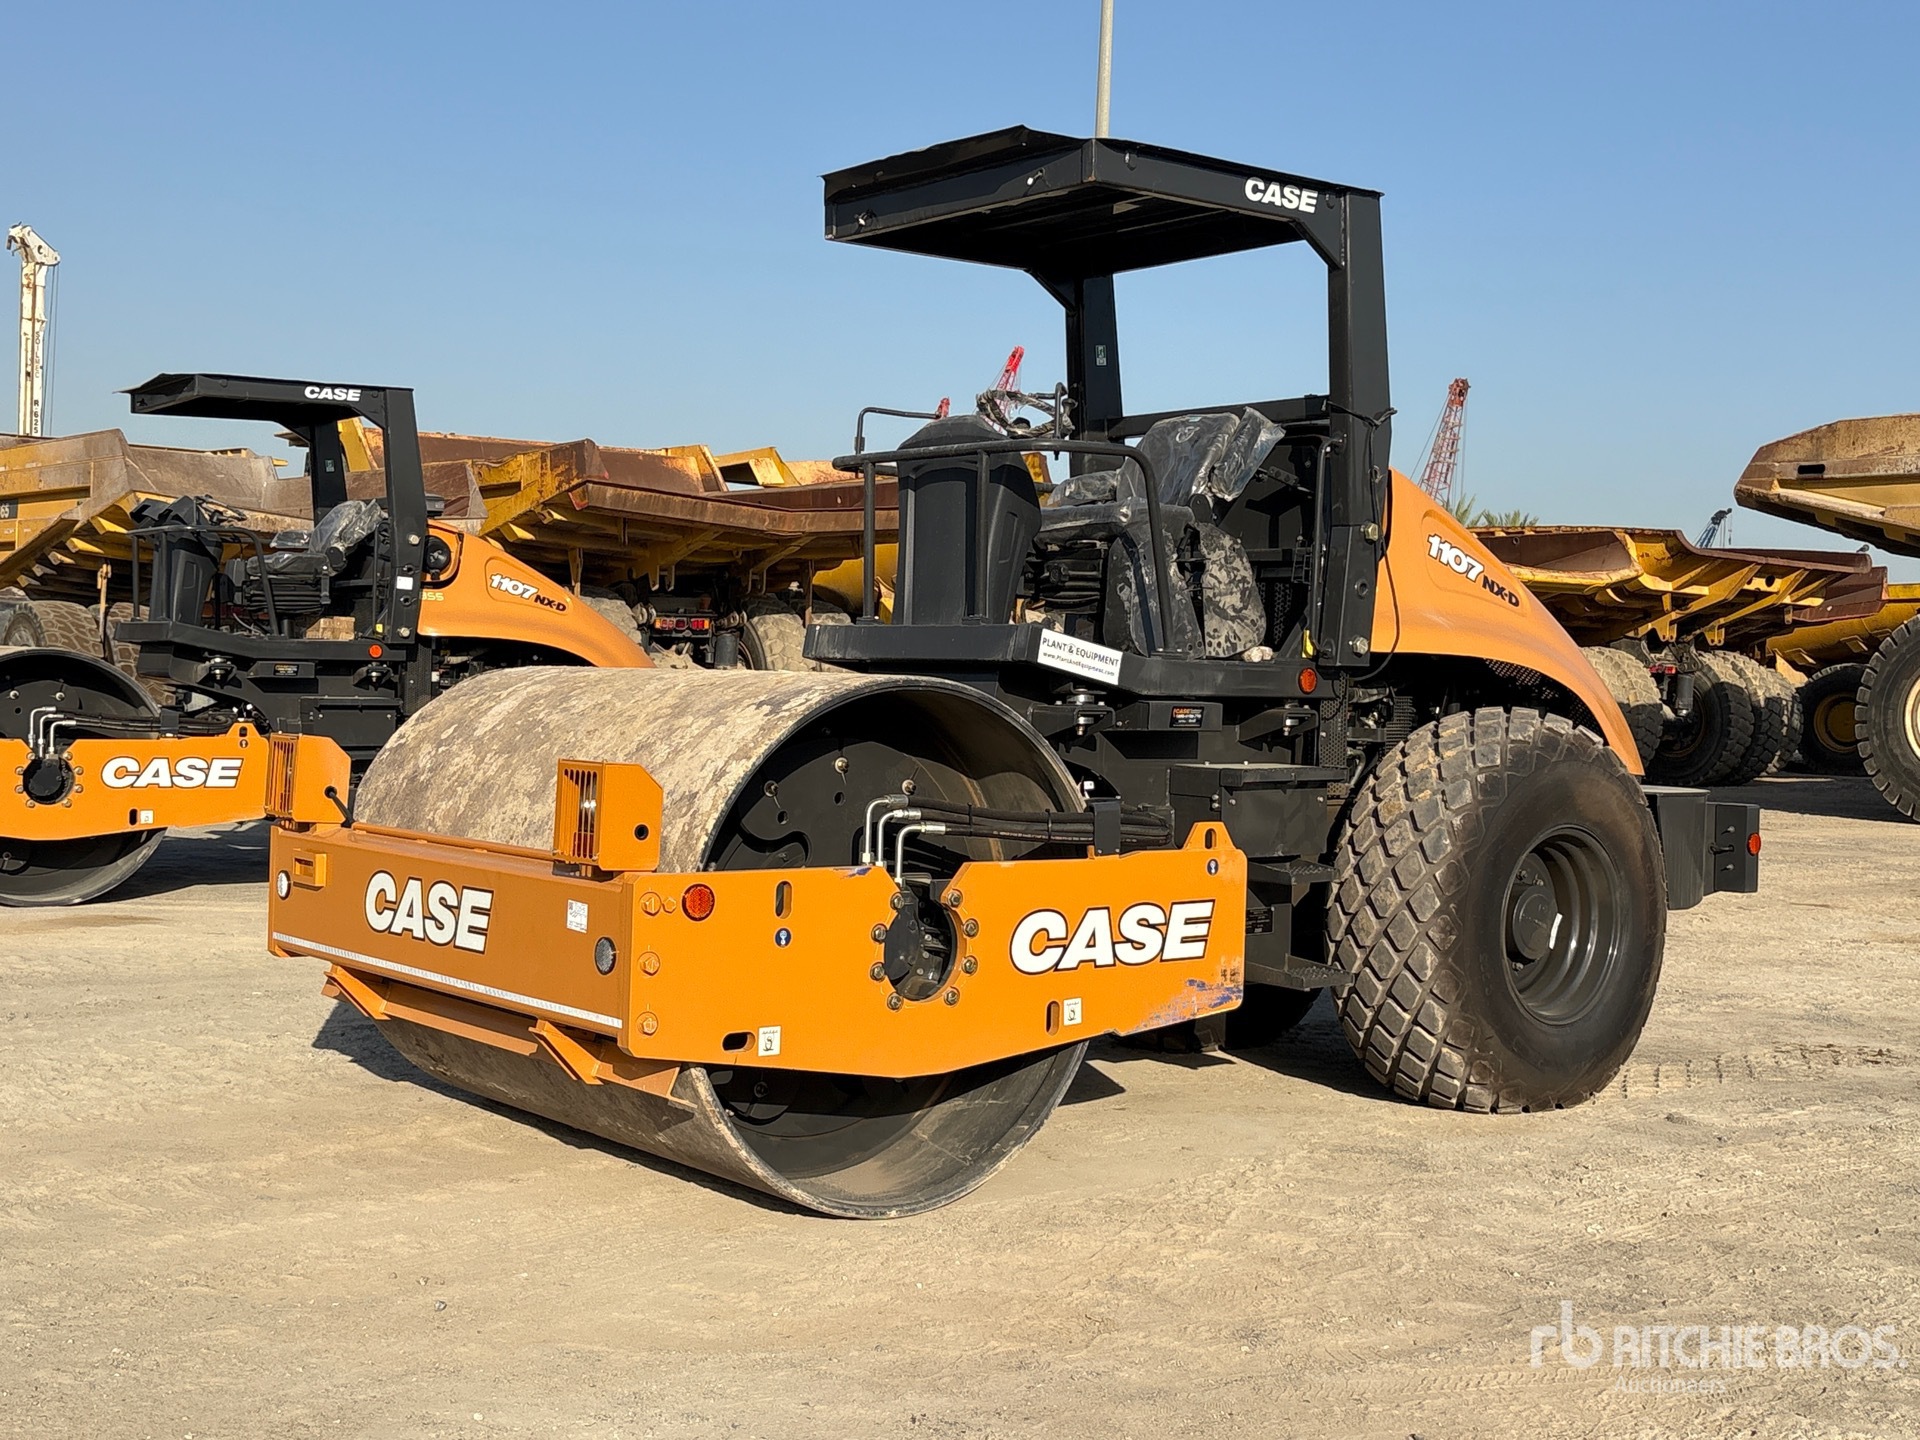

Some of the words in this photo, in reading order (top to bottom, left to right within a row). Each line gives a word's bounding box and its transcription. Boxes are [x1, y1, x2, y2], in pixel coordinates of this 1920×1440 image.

[1245, 176, 1318, 213] CASE
[304, 386, 361, 402] CASE
[1427, 533, 1485, 583] 1107
[490, 573, 539, 600] 1107
[1042, 637, 1067, 651] PLANT
[1075, 647, 1119, 667] EQUIPMENT
[101, 756, 244, 788] CASE
[365, 870, 493, 954] CASE
[1009, 899, 1215, 975] CASE
